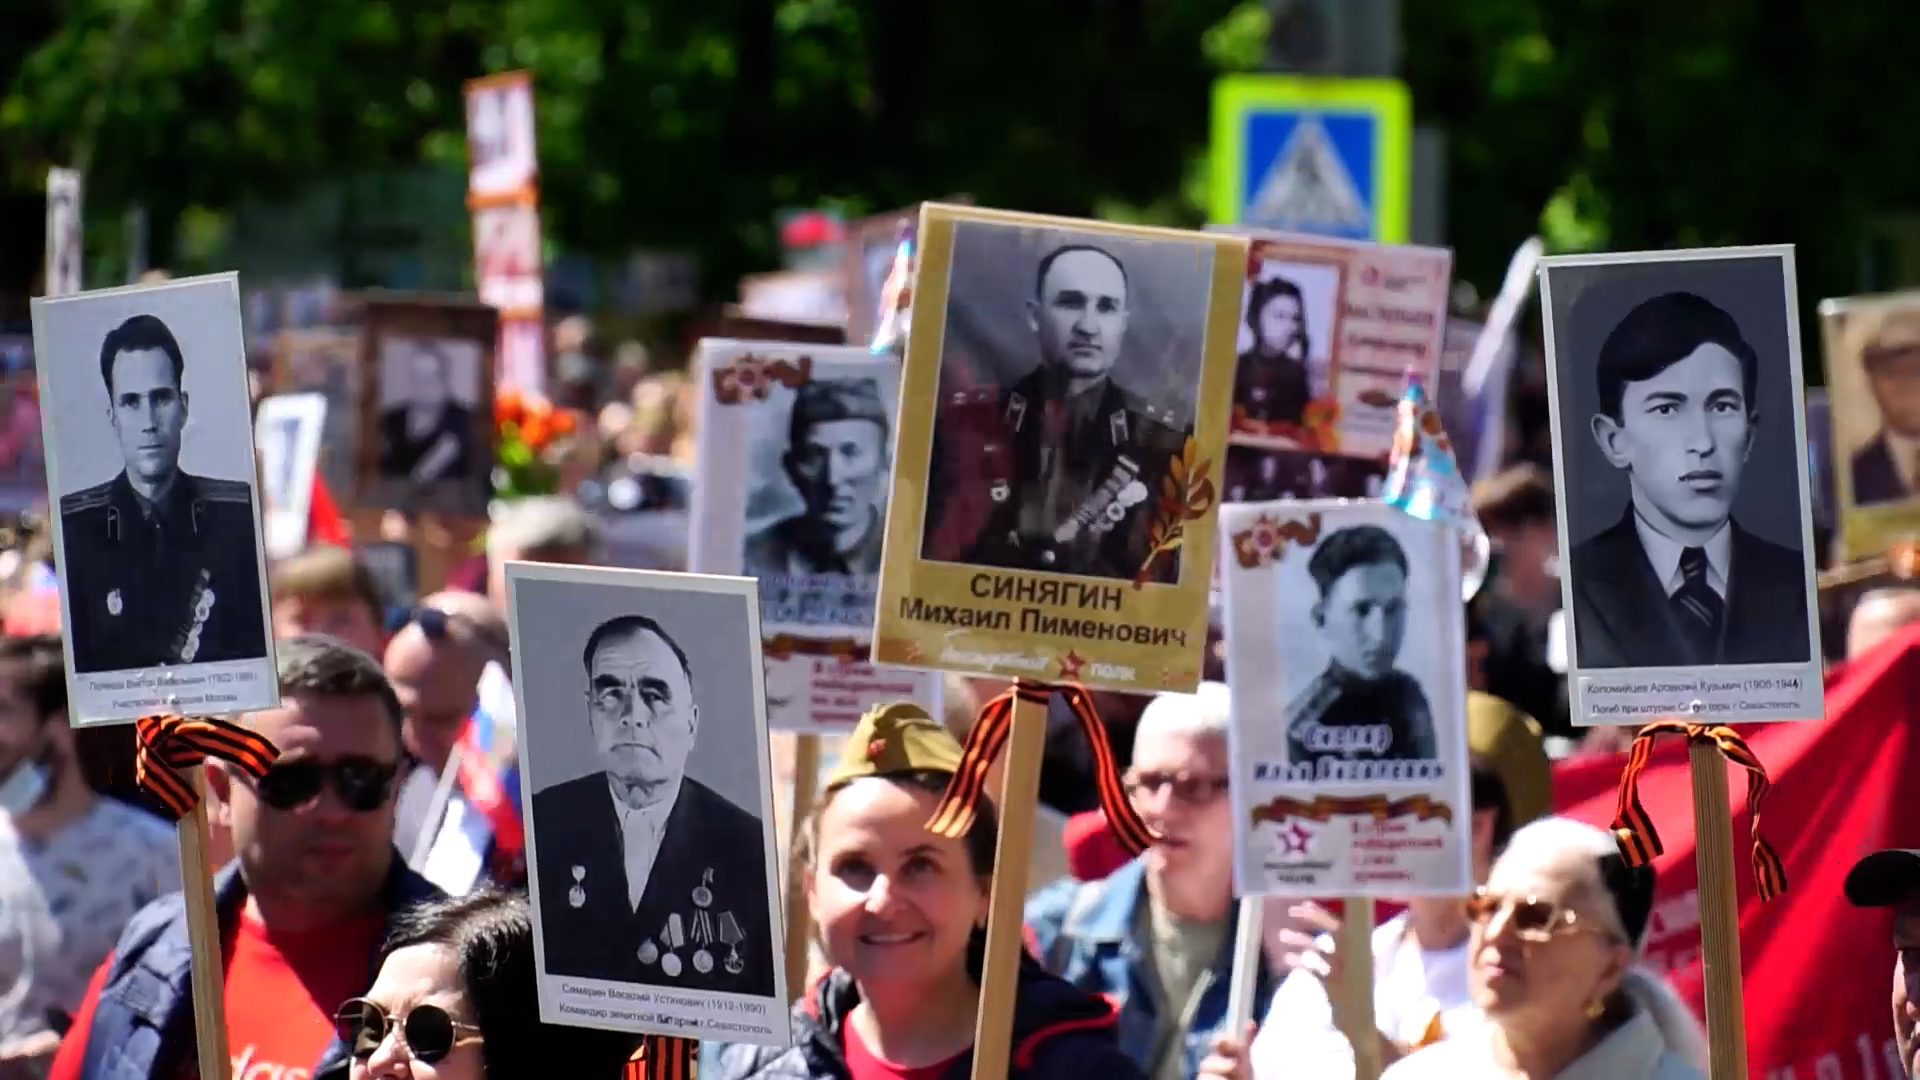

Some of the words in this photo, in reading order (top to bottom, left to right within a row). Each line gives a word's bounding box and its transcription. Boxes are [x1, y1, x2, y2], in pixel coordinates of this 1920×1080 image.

[970, 573, 1122, 612] СИНЯГИН
[900, 596, 1011, 632] Михаил
[1020, 607, 1186, 648] Пименович
[560, 1002, 608, 1019] Командир
[654, 992, 704, 1008] Устинович
